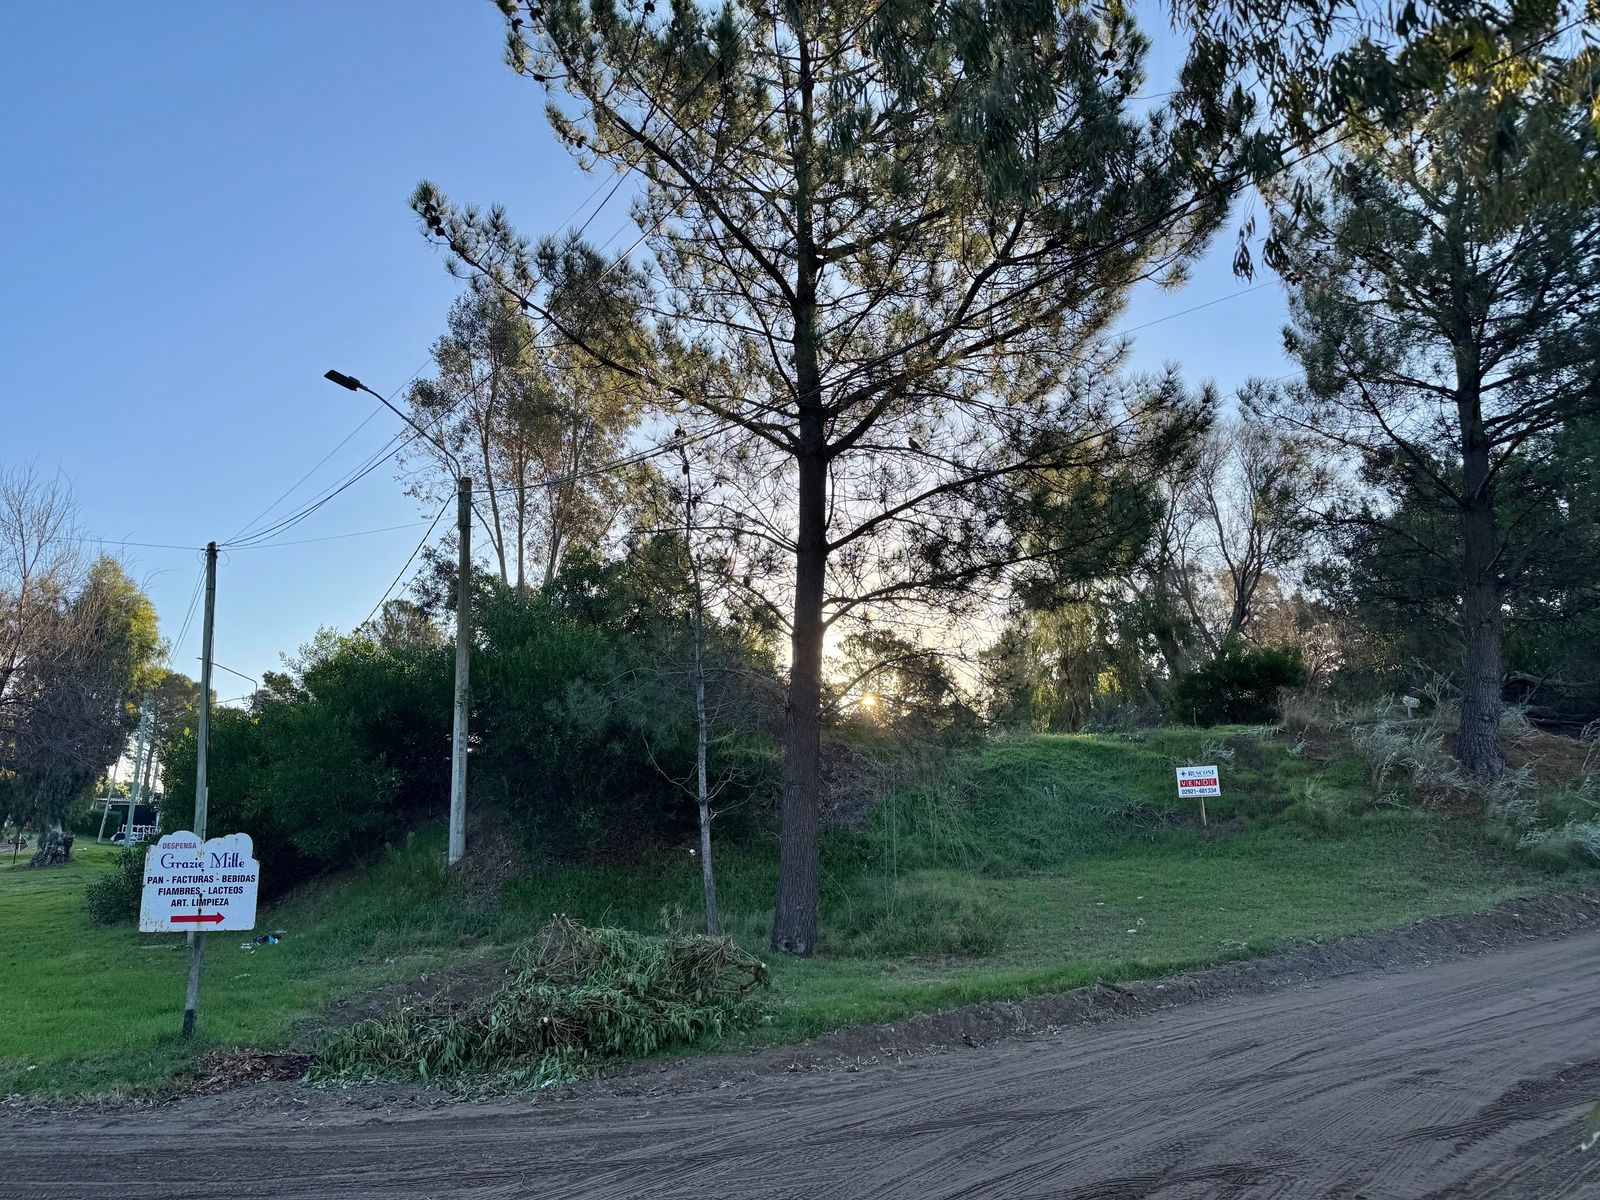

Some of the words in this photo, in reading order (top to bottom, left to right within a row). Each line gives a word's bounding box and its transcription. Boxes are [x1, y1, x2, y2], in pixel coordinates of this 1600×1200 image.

[160, 853, 205, 869] Grazie
[209, 852, 245, 869] Mille
[147, 876, 164, 884] PAN
[172, 875, 214, 884] FACTURAS
[221, 874, 256, 883] BEBIDAS
[158, 887, 200, 896] FIAMBRES
[208, 886, 244, 895] LACTEOS
[170, 899, 189, 907] ART.
[191, 898, 229, 907] LIMPIEZA
